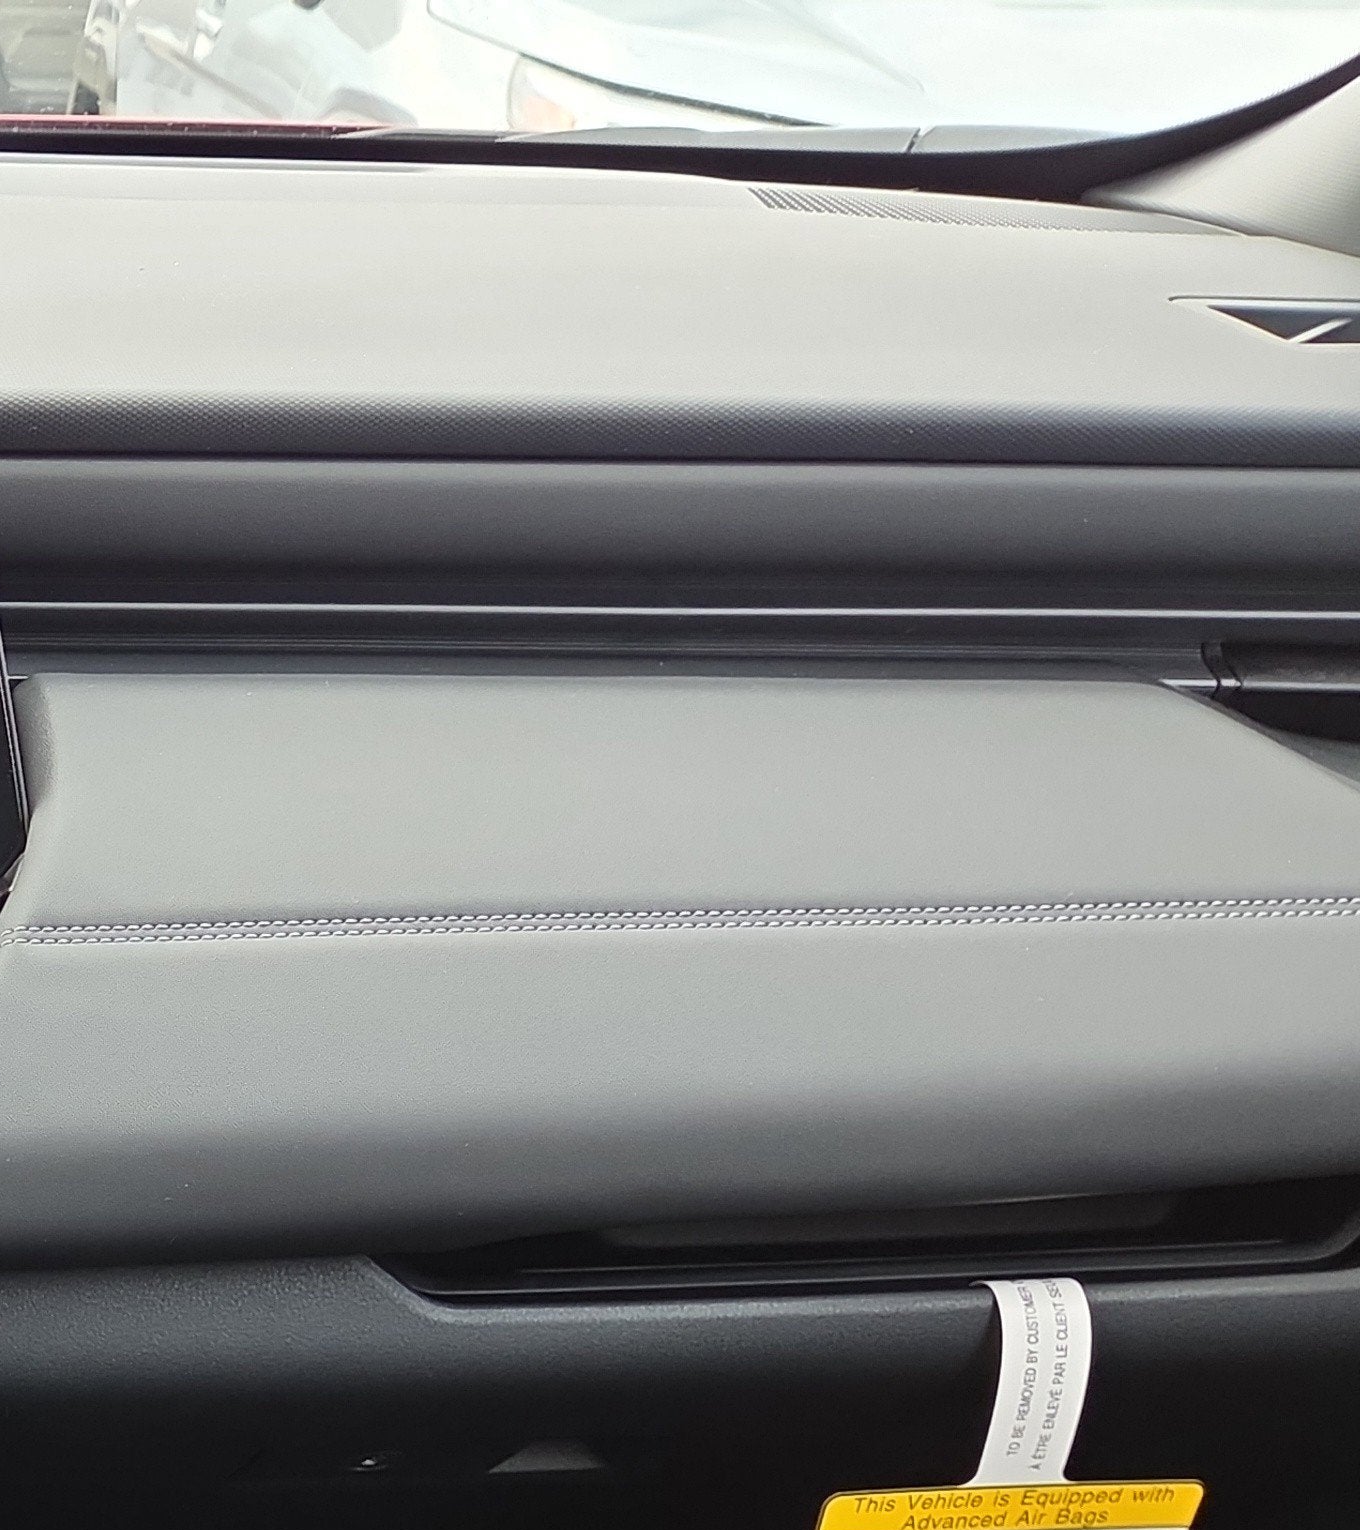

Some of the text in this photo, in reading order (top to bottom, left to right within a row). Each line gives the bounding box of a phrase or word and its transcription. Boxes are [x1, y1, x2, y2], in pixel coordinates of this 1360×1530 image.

[1055, 1344, 1068, 1360] LE
[1053, 1361, 1067, 1385] PAR
[1007, 1441, 1021, 1456] TO
[1016, 1367, 1036, 1422] REMOVED
[1026, 1349, 1038, 1363] BY
[854, 1486, 1175, 1514] This Vehicle is Equipped with
[901, 1507, 1109, 1530] Advanced Air Bags
